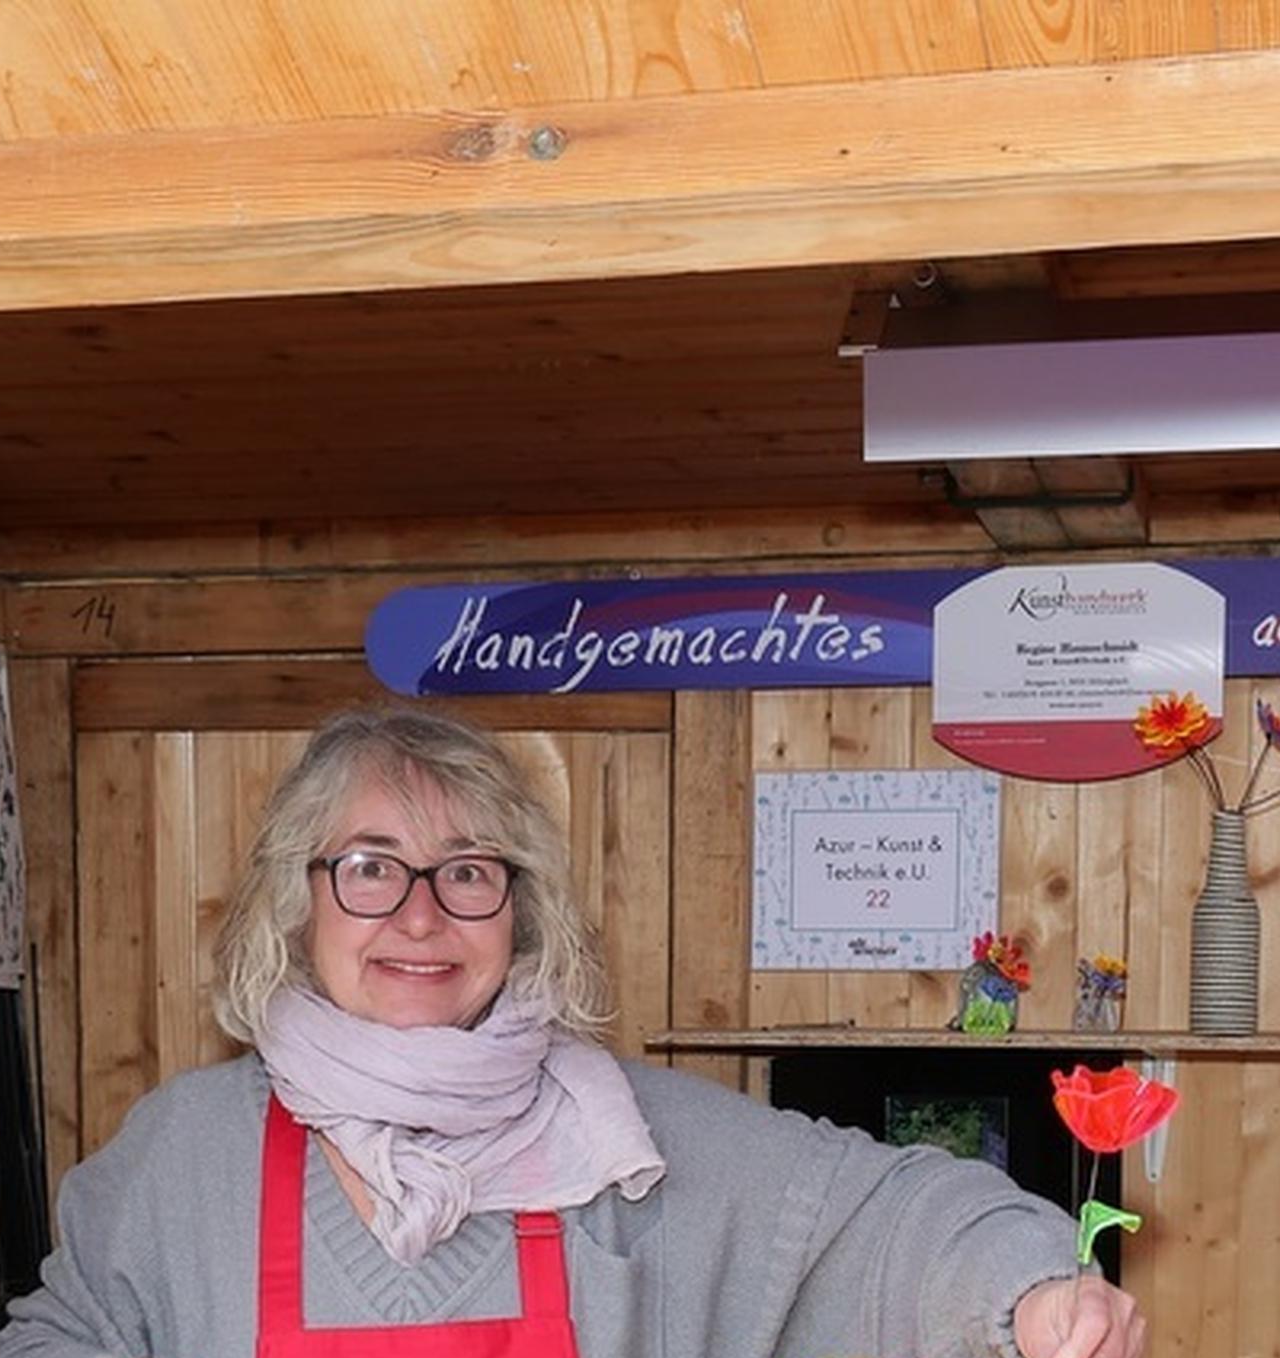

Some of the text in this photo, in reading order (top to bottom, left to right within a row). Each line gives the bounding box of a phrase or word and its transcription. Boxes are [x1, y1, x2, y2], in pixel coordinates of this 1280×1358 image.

[72, 596, 116, 638] 14
[435, 593, 886, 693] Handgemachtes
[814, 836, 855, 852] Azur
[876, 834, 923, 852] Kunst
[928, 834, 942, 852] &
[826, 863, 931, 881] Technik e.U.
[866, 889, 891, 909] 22
